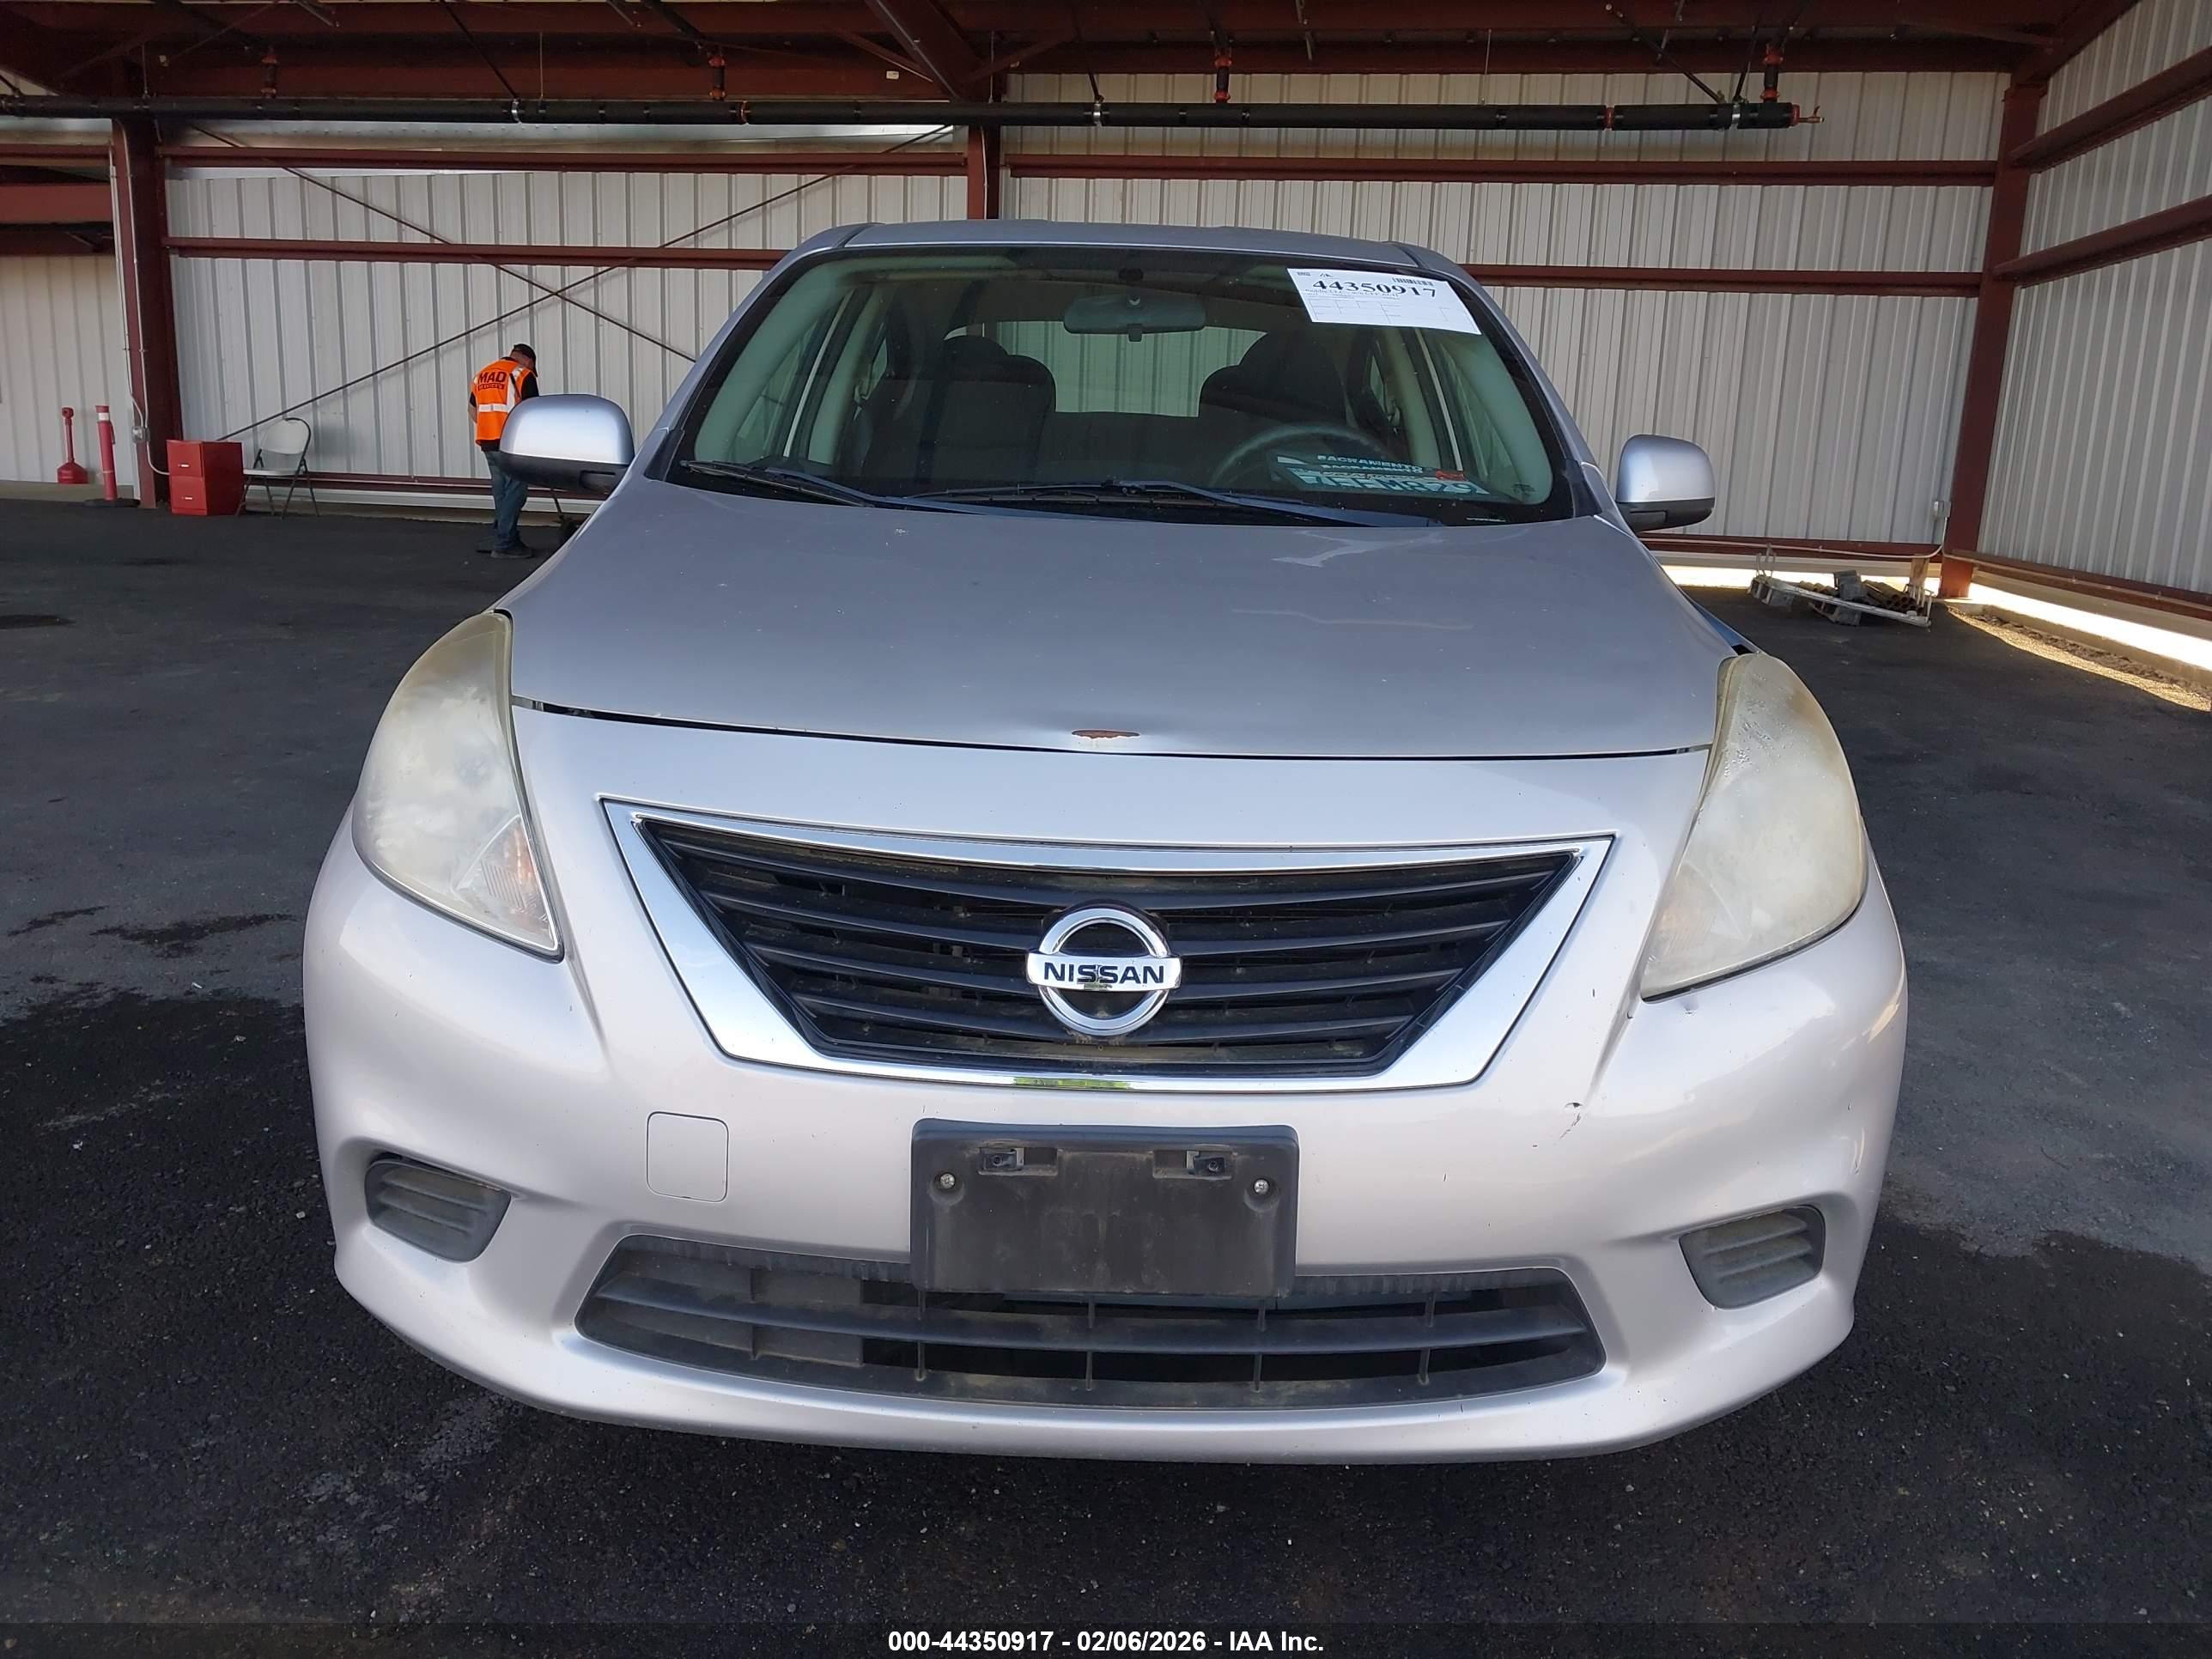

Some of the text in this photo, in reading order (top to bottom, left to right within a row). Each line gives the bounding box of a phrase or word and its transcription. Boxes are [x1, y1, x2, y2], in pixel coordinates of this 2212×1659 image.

[1312, 279, 1437, 299] 44350917
[479, 371, 507, 383] MAD
[1316, 454, 1424, 471] SACRAMENTO
[1043, 962, 1164, 985] NISSAN
